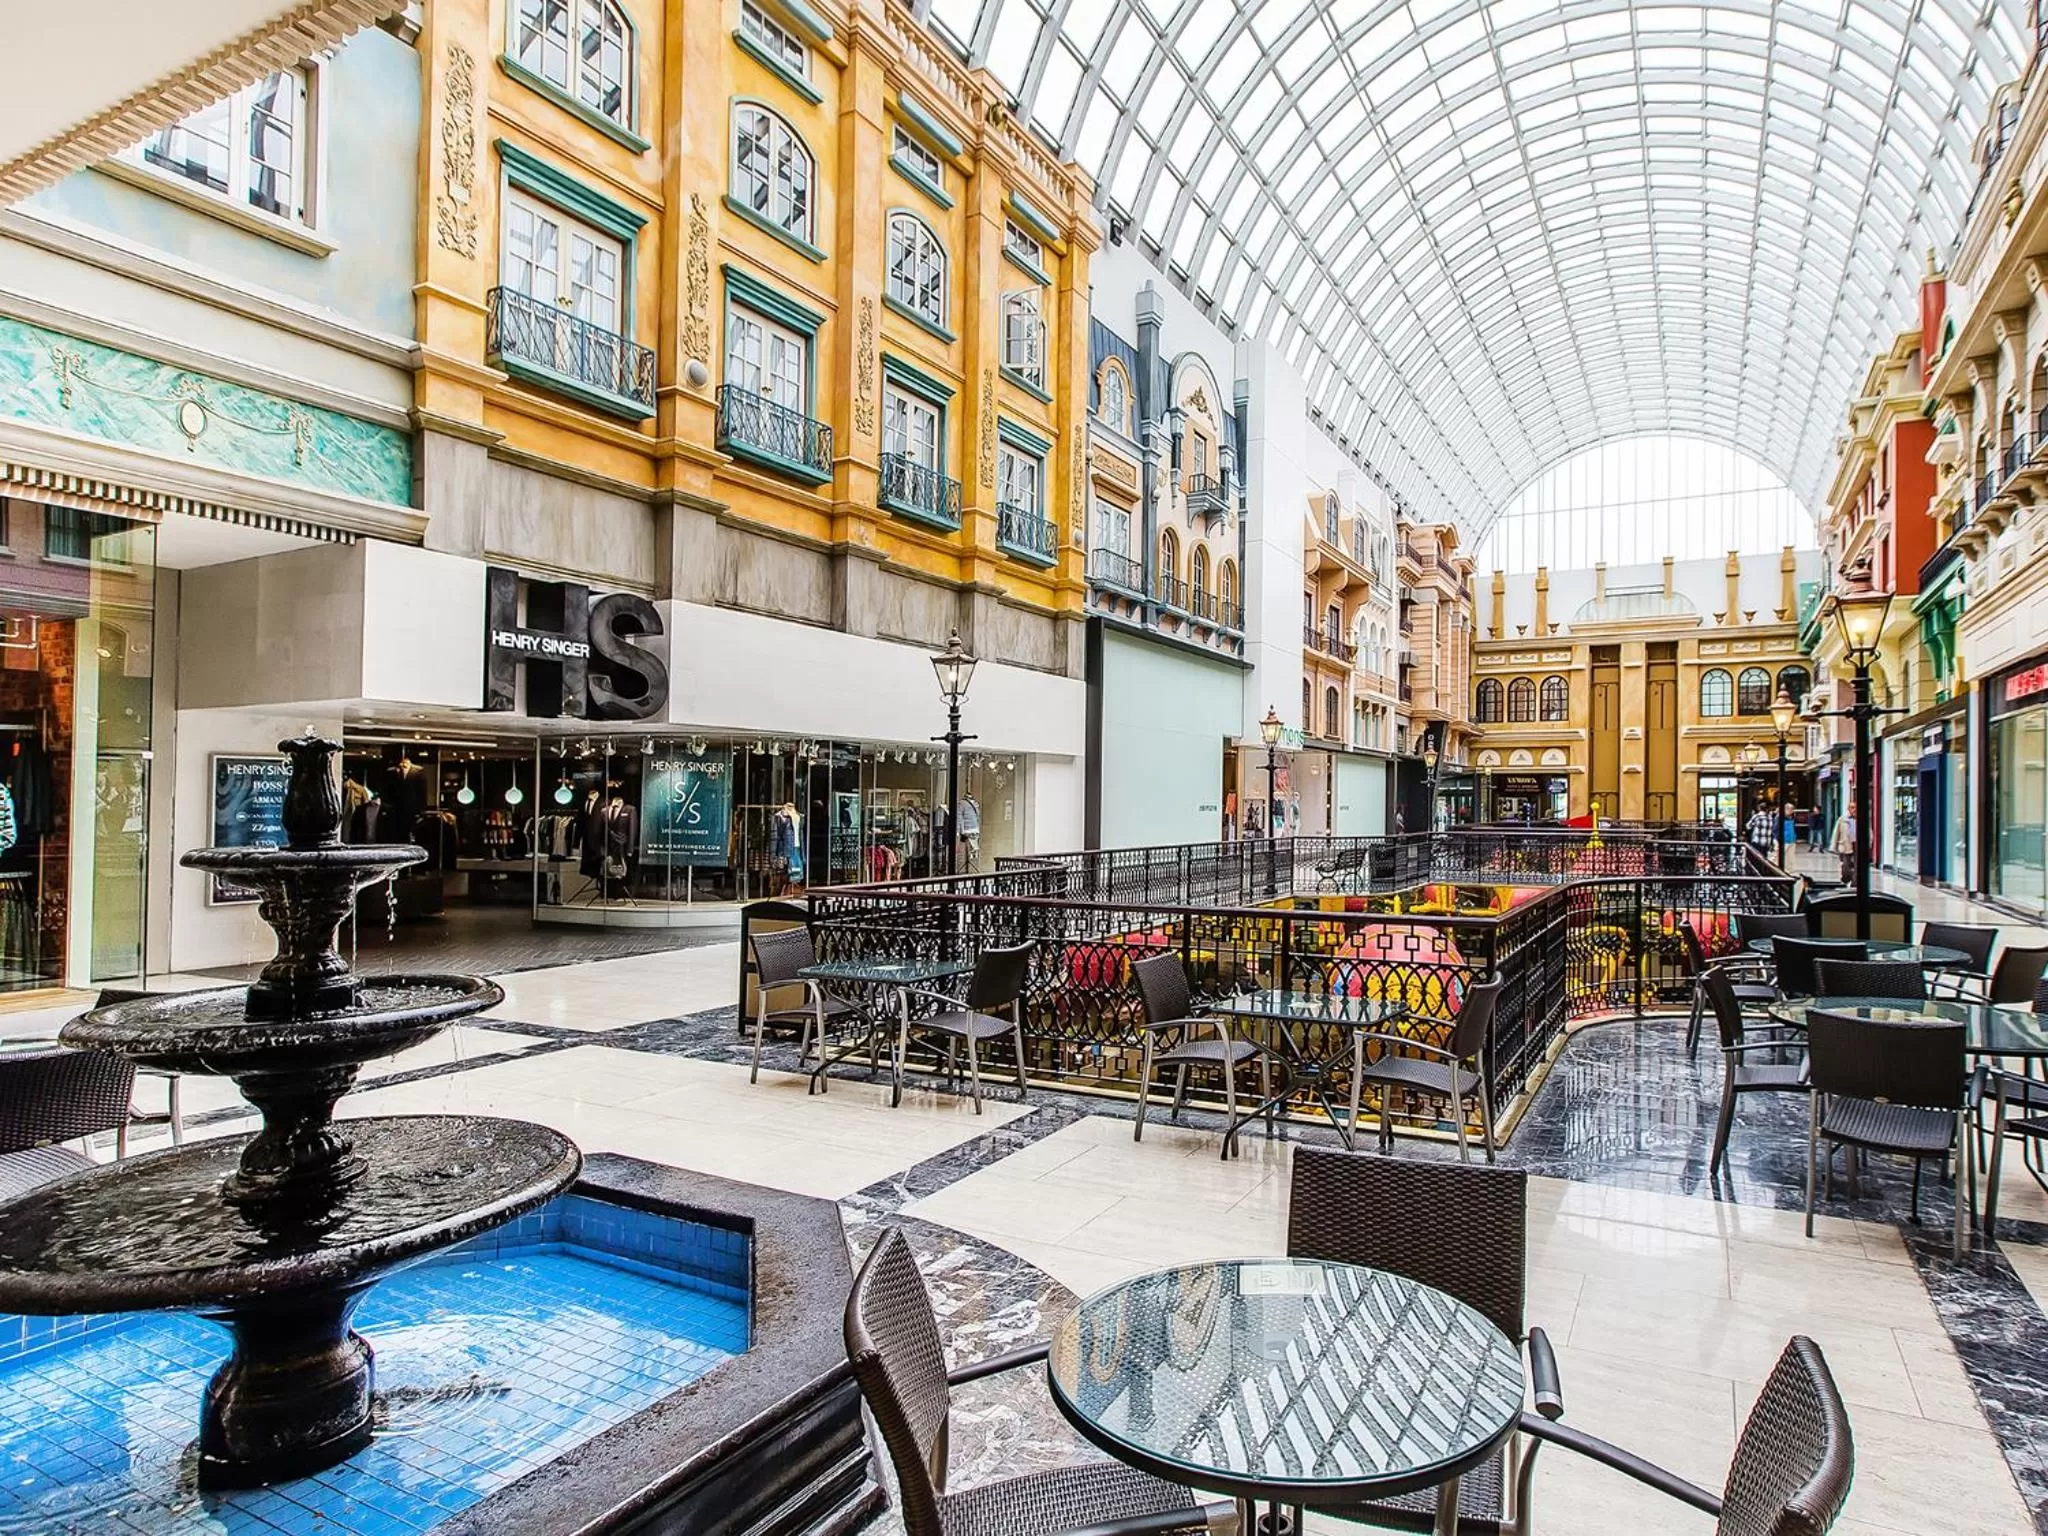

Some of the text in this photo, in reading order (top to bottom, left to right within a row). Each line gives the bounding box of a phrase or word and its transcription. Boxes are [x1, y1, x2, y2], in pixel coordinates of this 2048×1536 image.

[487, 566, 670, 721] HS
[492, 630, 590, 658] HENRY SINGER
[227, 764, 293, 776] HENRY SING
[650, 761, 724, 773] HENRY SINGER
[253, 781, 283, 790] BOSS
